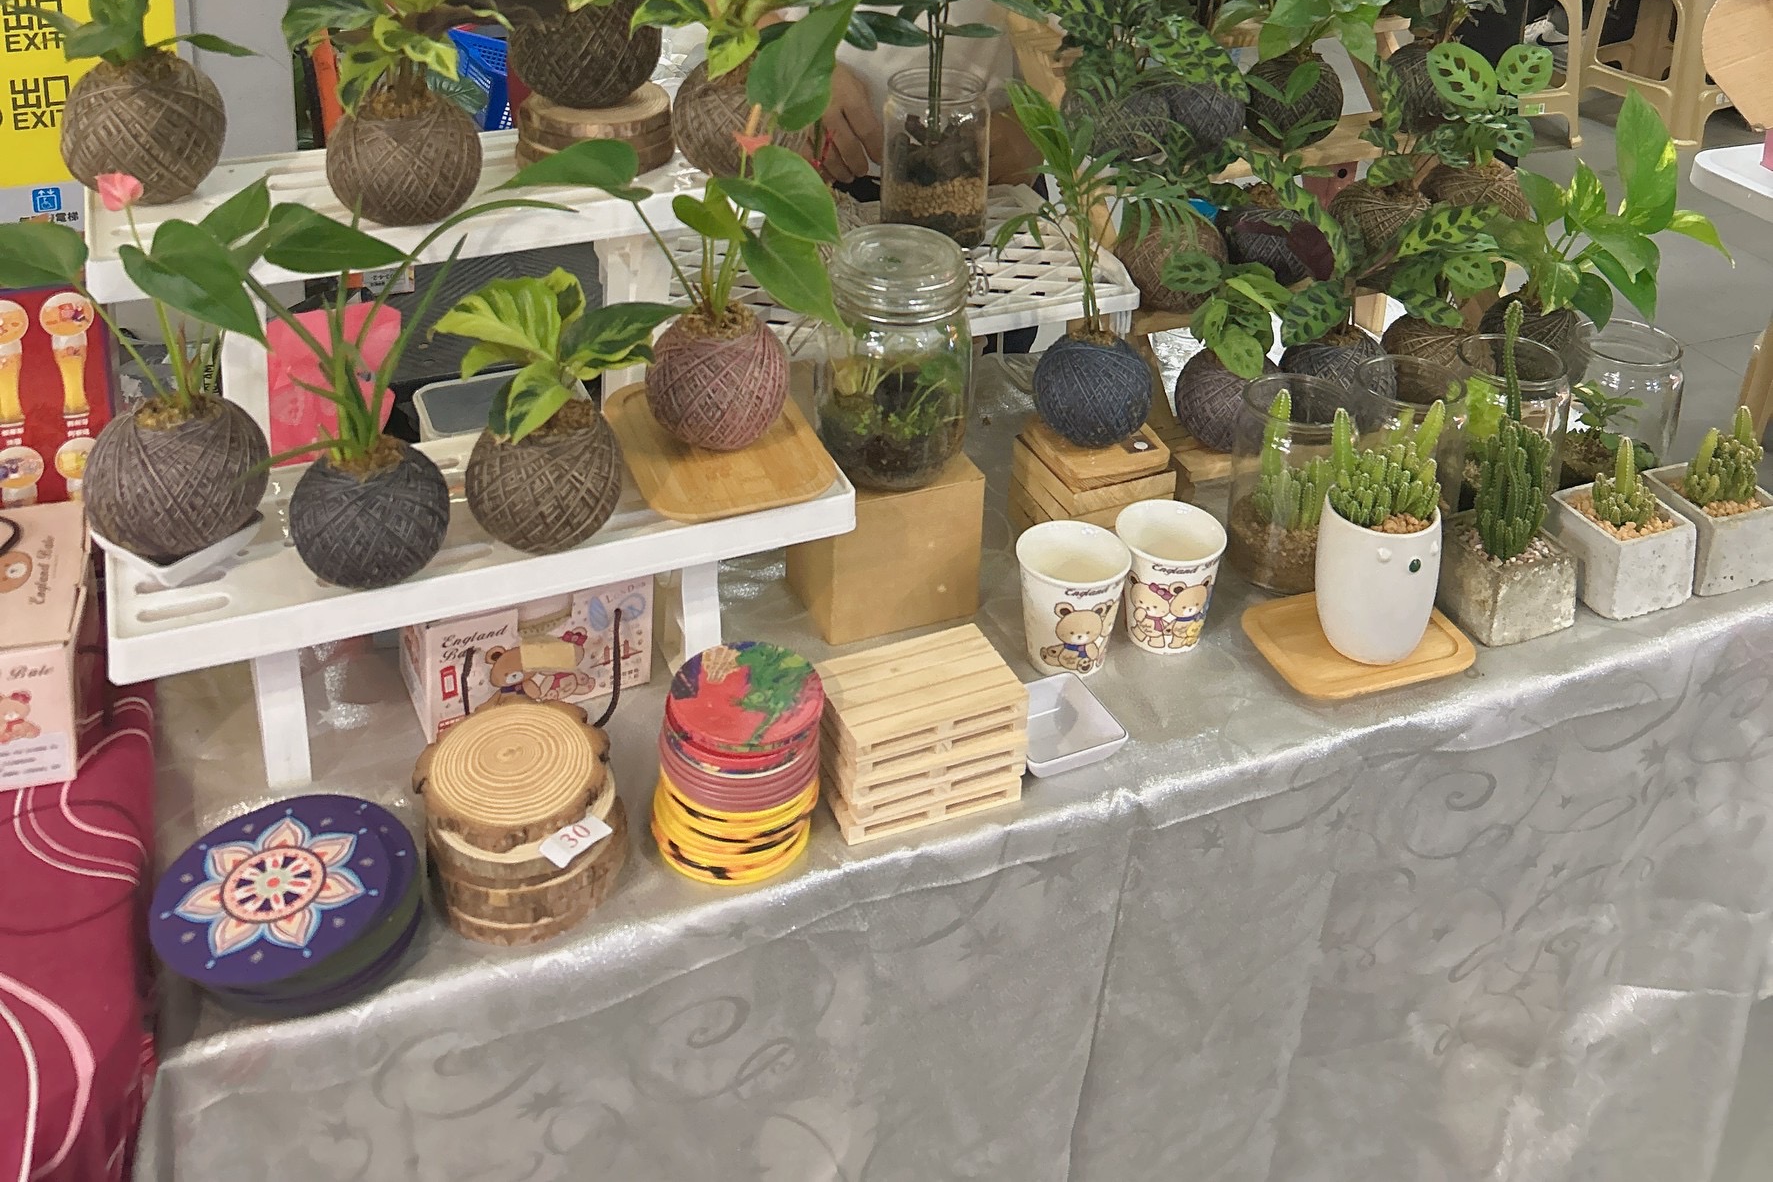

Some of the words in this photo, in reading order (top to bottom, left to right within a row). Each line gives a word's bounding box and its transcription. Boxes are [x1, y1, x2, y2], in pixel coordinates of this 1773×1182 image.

[5, 31, 62, 53] EXIT
[10, 75, 70, 111] 出口
[442, 624, 509, 648] England
[560, 824, 590, 849] 30
